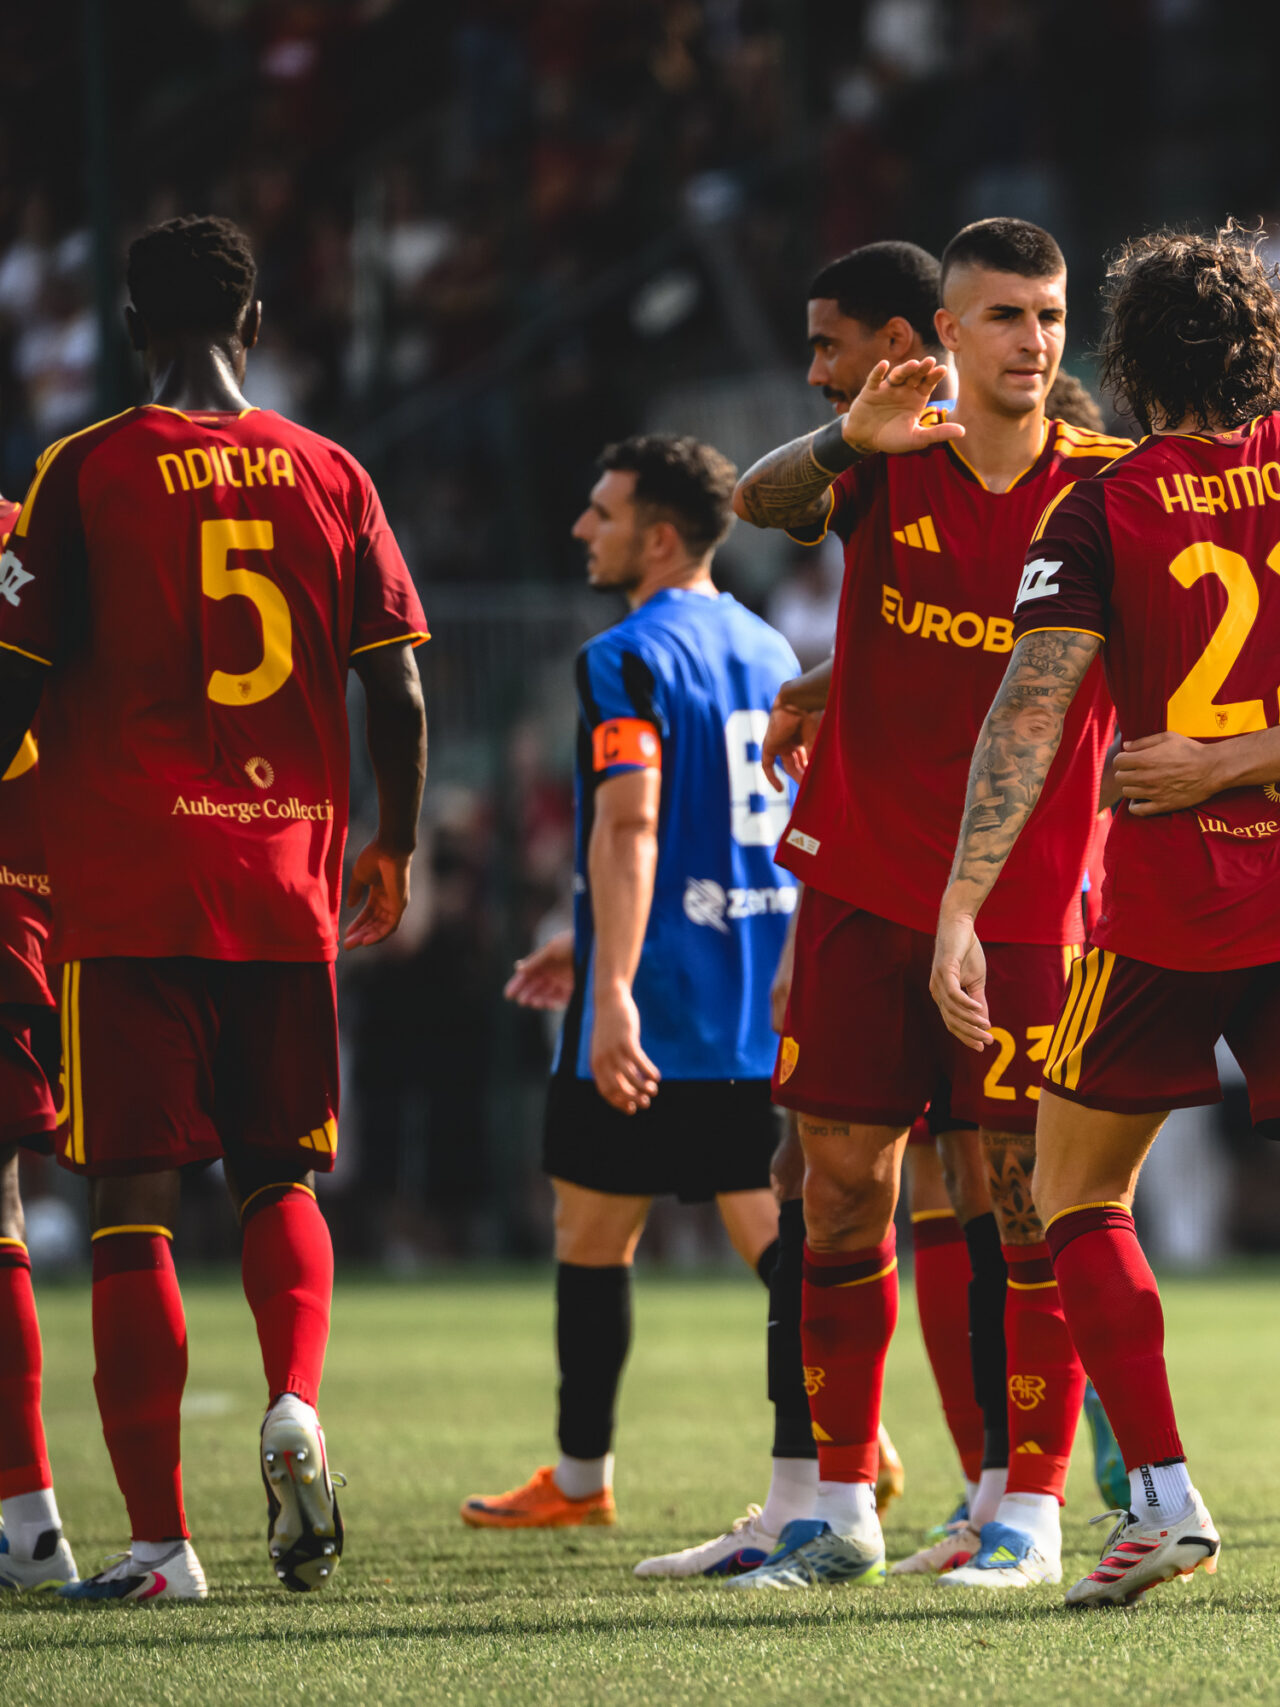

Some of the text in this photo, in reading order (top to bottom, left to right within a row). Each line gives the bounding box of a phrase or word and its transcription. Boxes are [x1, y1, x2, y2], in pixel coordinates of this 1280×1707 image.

[156, 446, 297, 494] NDICKA
[201, 519, 293, 706] 5
[881, 583, 1015, 653] EUROB
[603, 726, 619, 759] C
[171, 795, 262, 824] Auberge
[1140, 1463, 1160, 1507] DESIGN
